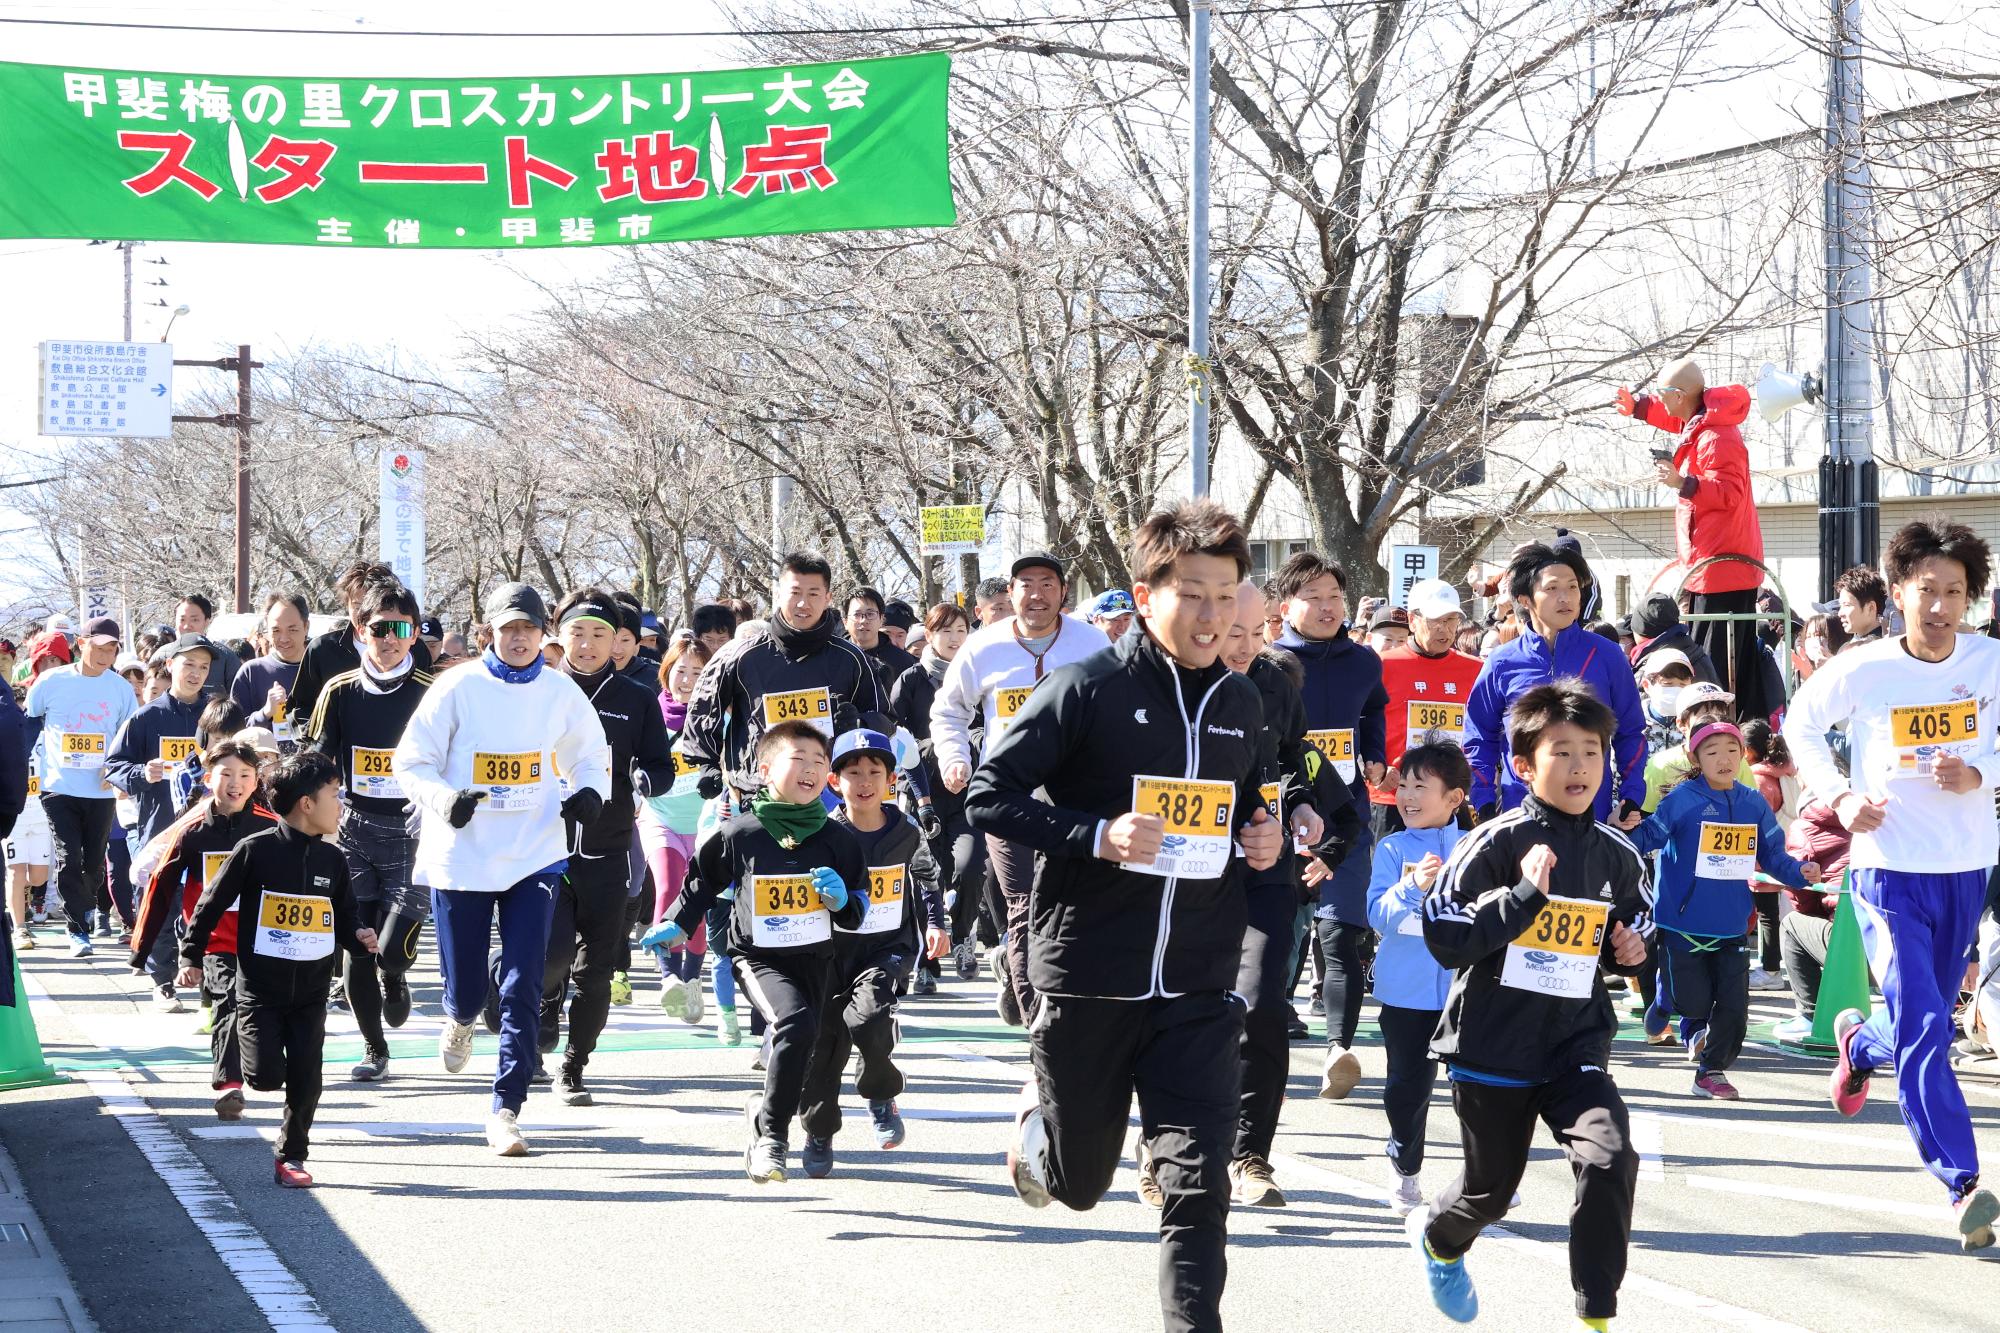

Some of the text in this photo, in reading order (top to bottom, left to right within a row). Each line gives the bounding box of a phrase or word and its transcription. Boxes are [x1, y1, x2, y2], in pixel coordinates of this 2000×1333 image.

[63, 67, 870, 128] 甲斐梅の里クロスカントリー大会
[116, 124, 838, 209] スタート地点
[317, 214, 653, 244] 主催・甲斐市
[52, 344, 147, 356] 甲斐市役所敷島庁舎
[51, 363, 147, 376] 敷島総合文化会館
[51, 383, 126, 393] 敷島公民館
[50, 400, 126, 410] 敷島図書館
[50, 416, 126, 427] 敷島体育館
[422, 622, 430, 633] S
[1414, 682, 1456, 694] 甲斐
[778, 698, 826, 718] 343 B
[1421, 709, 1462, 725] 396 B
[1909, 713, 1975, 739] 405 B
[70, 738, 90, 750] 368
[855, 732, 869, 748] LA
[1344, 742, 1350, 753] B
[365, 755, 392, 772] 292
[487, 760, 539, 780] 389 B
[513, 786, 540, 795] メイコー
[1157, 792, 1228, 826] 382 B
[1270, 800, 1277, 813] B
[1189, 842, 1228, 853] メイコー
[1713, 832, 1755, 851] 291 B
[7, 842, 16, 859] 6
[894, 880, 900, 893] B
[769, 885, 808, 910] 343
[276, 904, 330, 927] 389 B
[792, 916, 821, 927] メイコー
[1537, 911, 1602, 946] 382 B
[1526, 962, 1554, 973] MEIKO
[1560, 961, 1590, 971] メイコー
